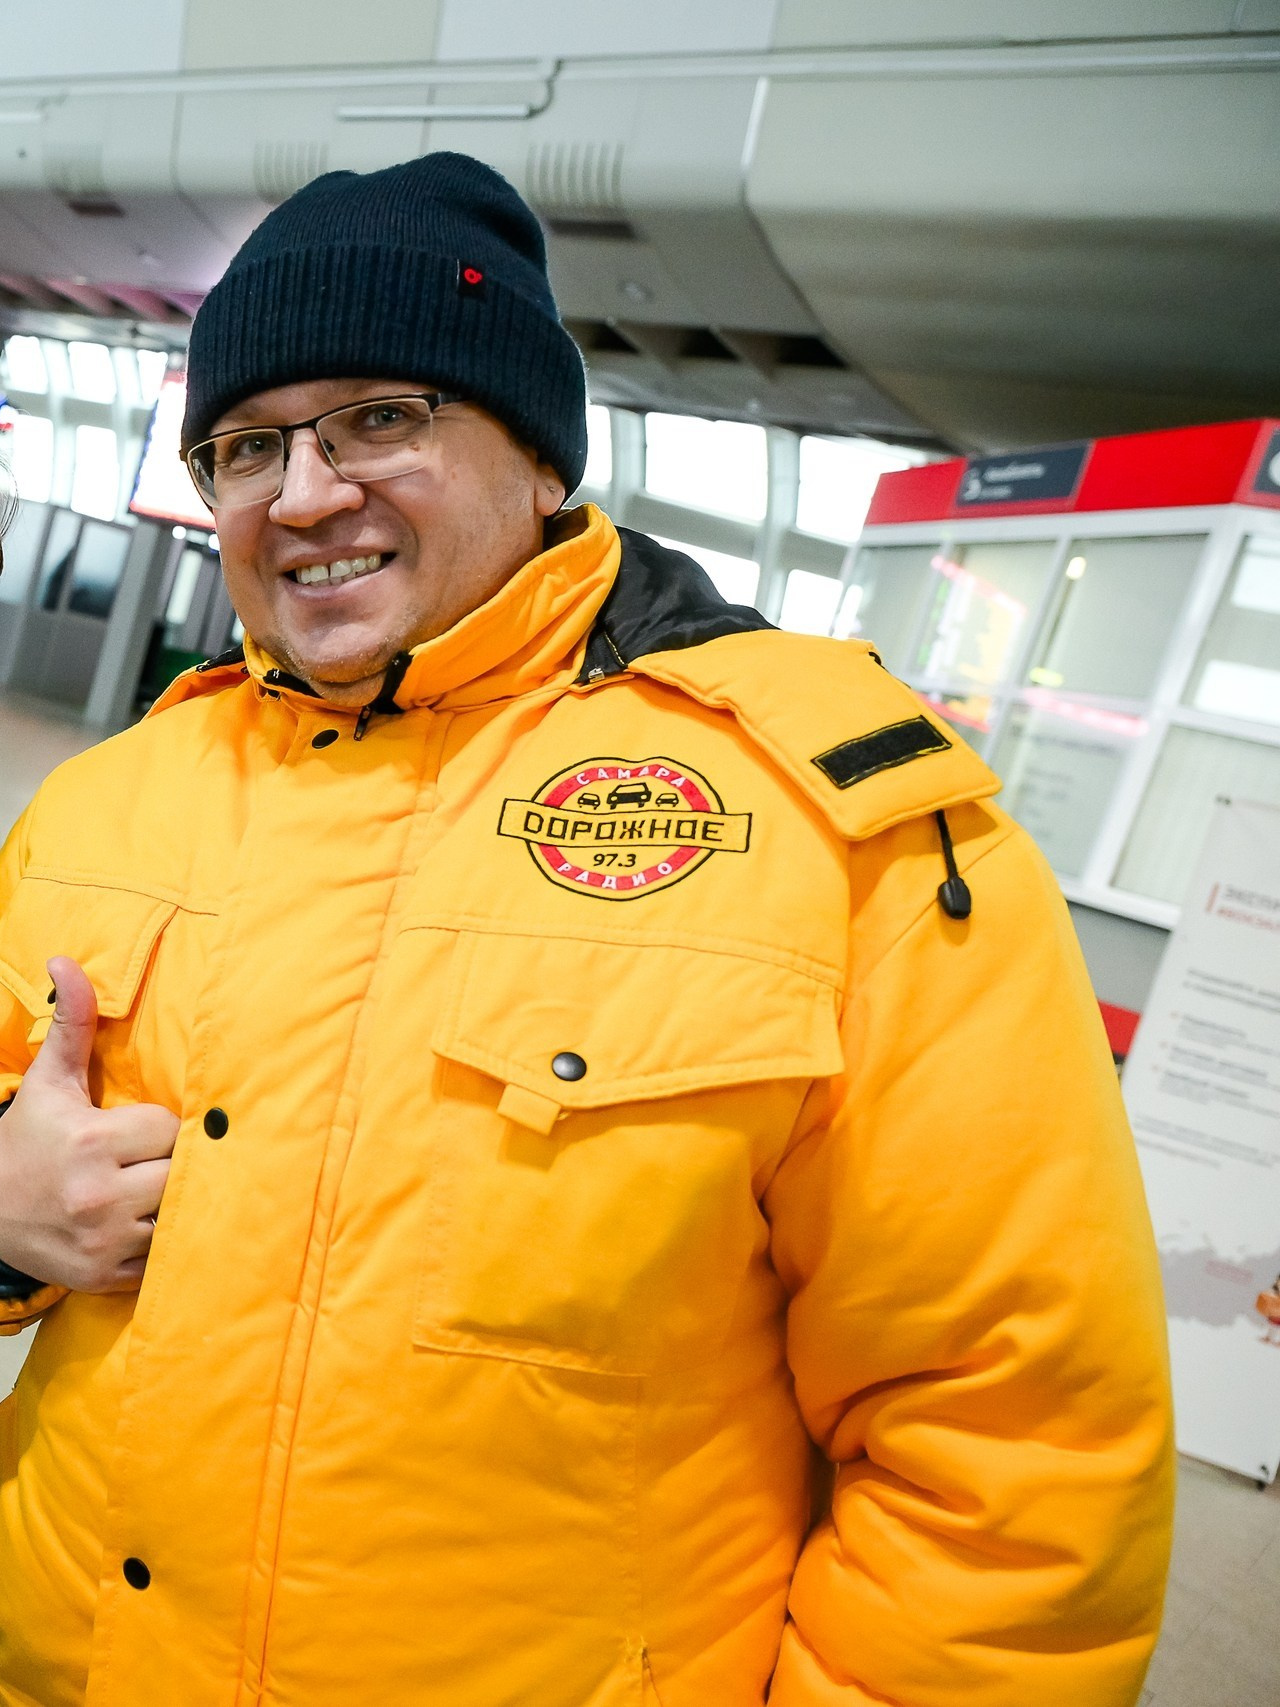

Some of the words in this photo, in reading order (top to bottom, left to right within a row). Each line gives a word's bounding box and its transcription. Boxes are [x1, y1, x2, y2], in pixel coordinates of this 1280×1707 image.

[576, 766, 686, 788] САМАРА
[592, 853, 637, 868] 97.3
[557, 862, 673, 890] РАДИО
